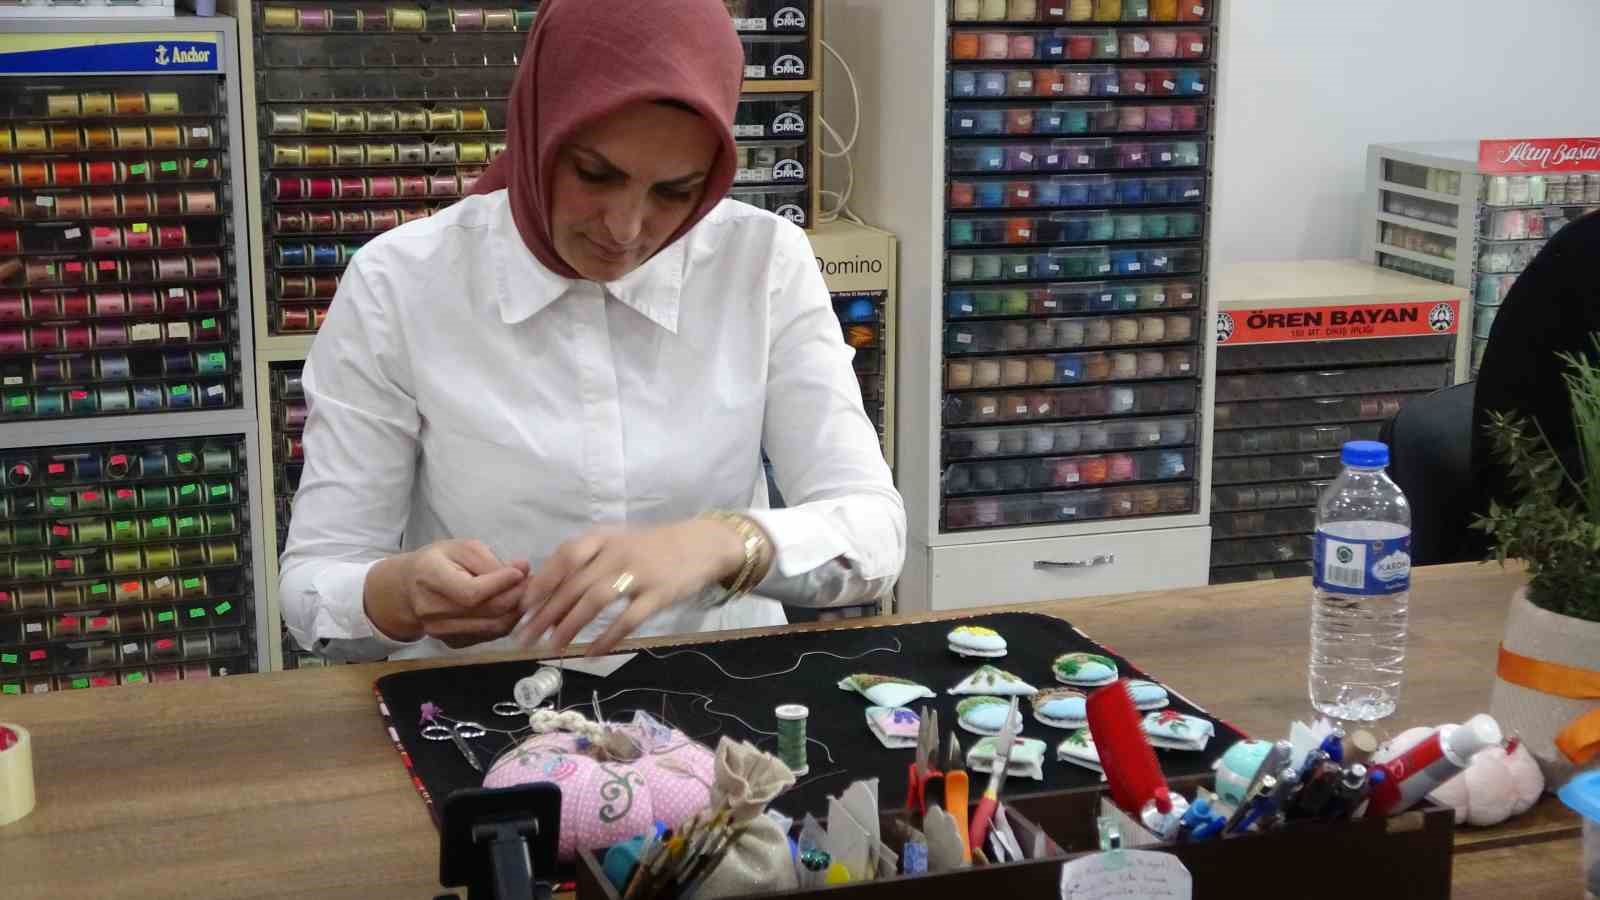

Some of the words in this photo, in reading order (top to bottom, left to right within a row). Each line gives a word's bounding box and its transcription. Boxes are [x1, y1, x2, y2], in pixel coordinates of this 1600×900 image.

[172, 46, 210, 63] Anchor
[1246, 310, 1323, 329] ÖREN
[1330, 307, 1419, 325] BAYAN
